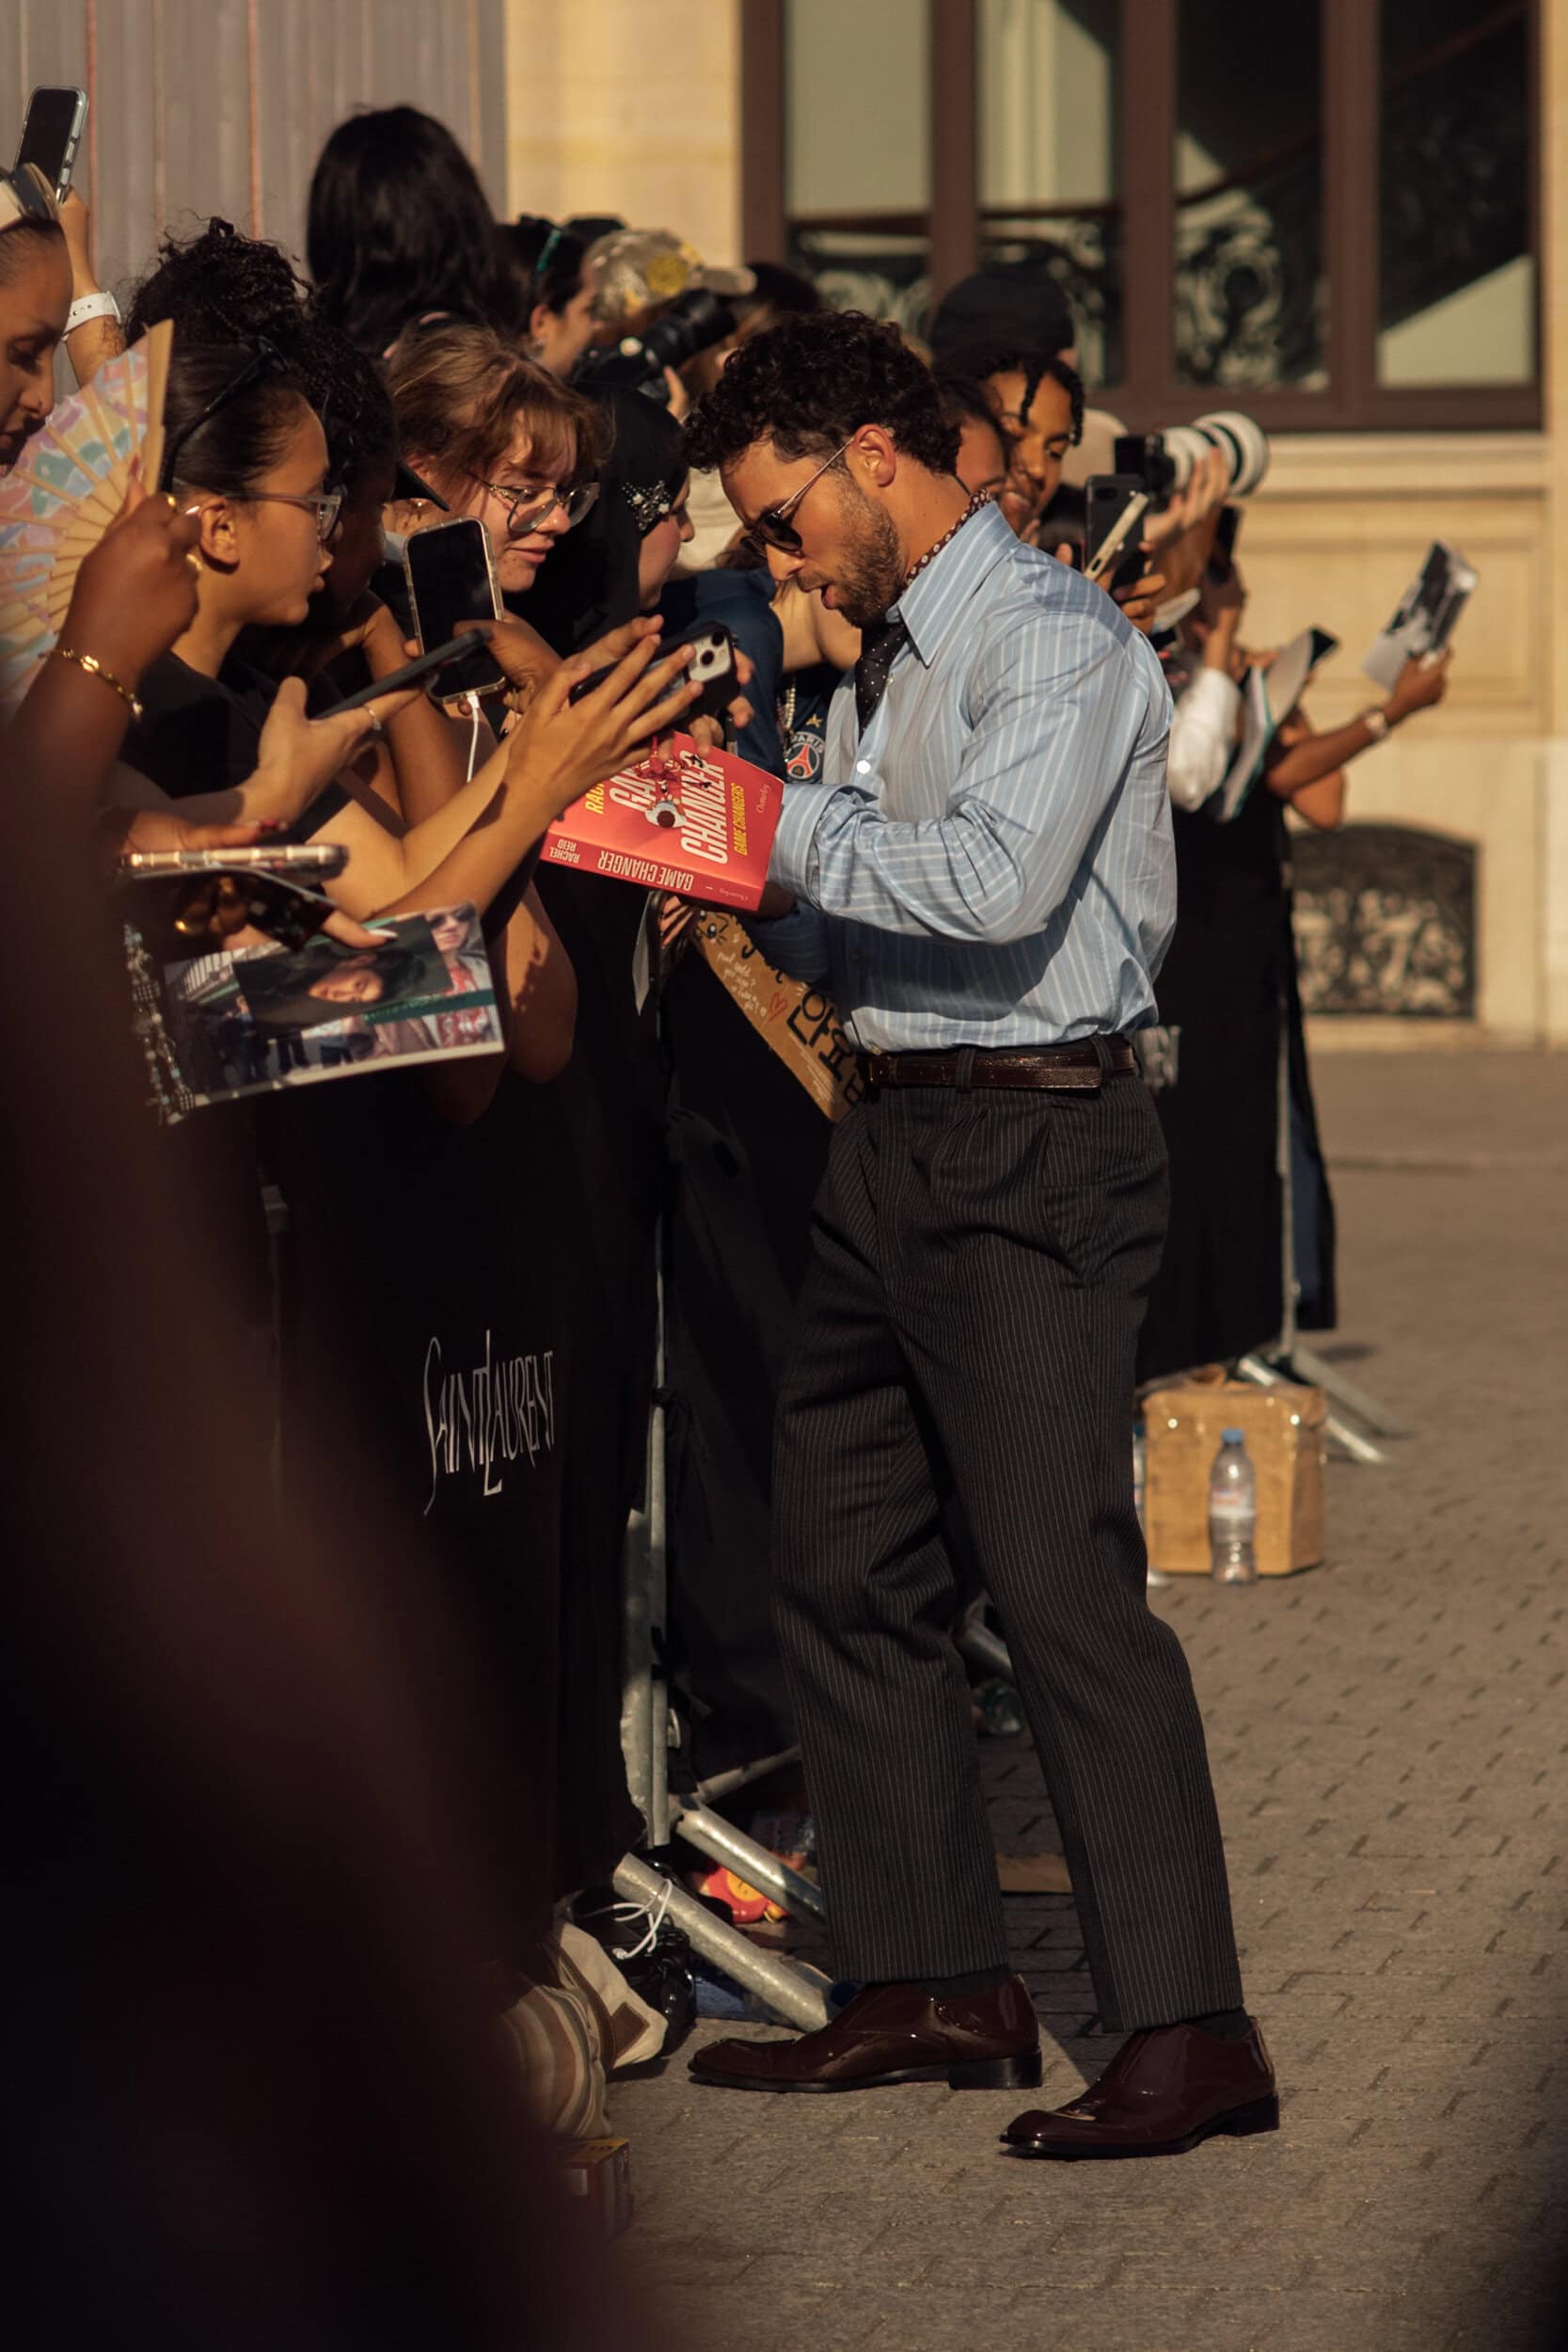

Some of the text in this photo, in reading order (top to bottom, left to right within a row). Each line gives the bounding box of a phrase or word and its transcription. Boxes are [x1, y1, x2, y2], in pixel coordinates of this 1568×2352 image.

[585, 782, 605, 815] RAC
[679, 749, 729, 865] CHANGER
[730, 782, 749, 856] GAME CHANGERS
[549, 846, 580, 864] RACHEL
[557, 838, 577, 853] REID
[597, 850, 658, 882] CHANGER
[656, 866, 694, 892] GAME
[423, 1328, 555, 1516] SAINT LAURENT
